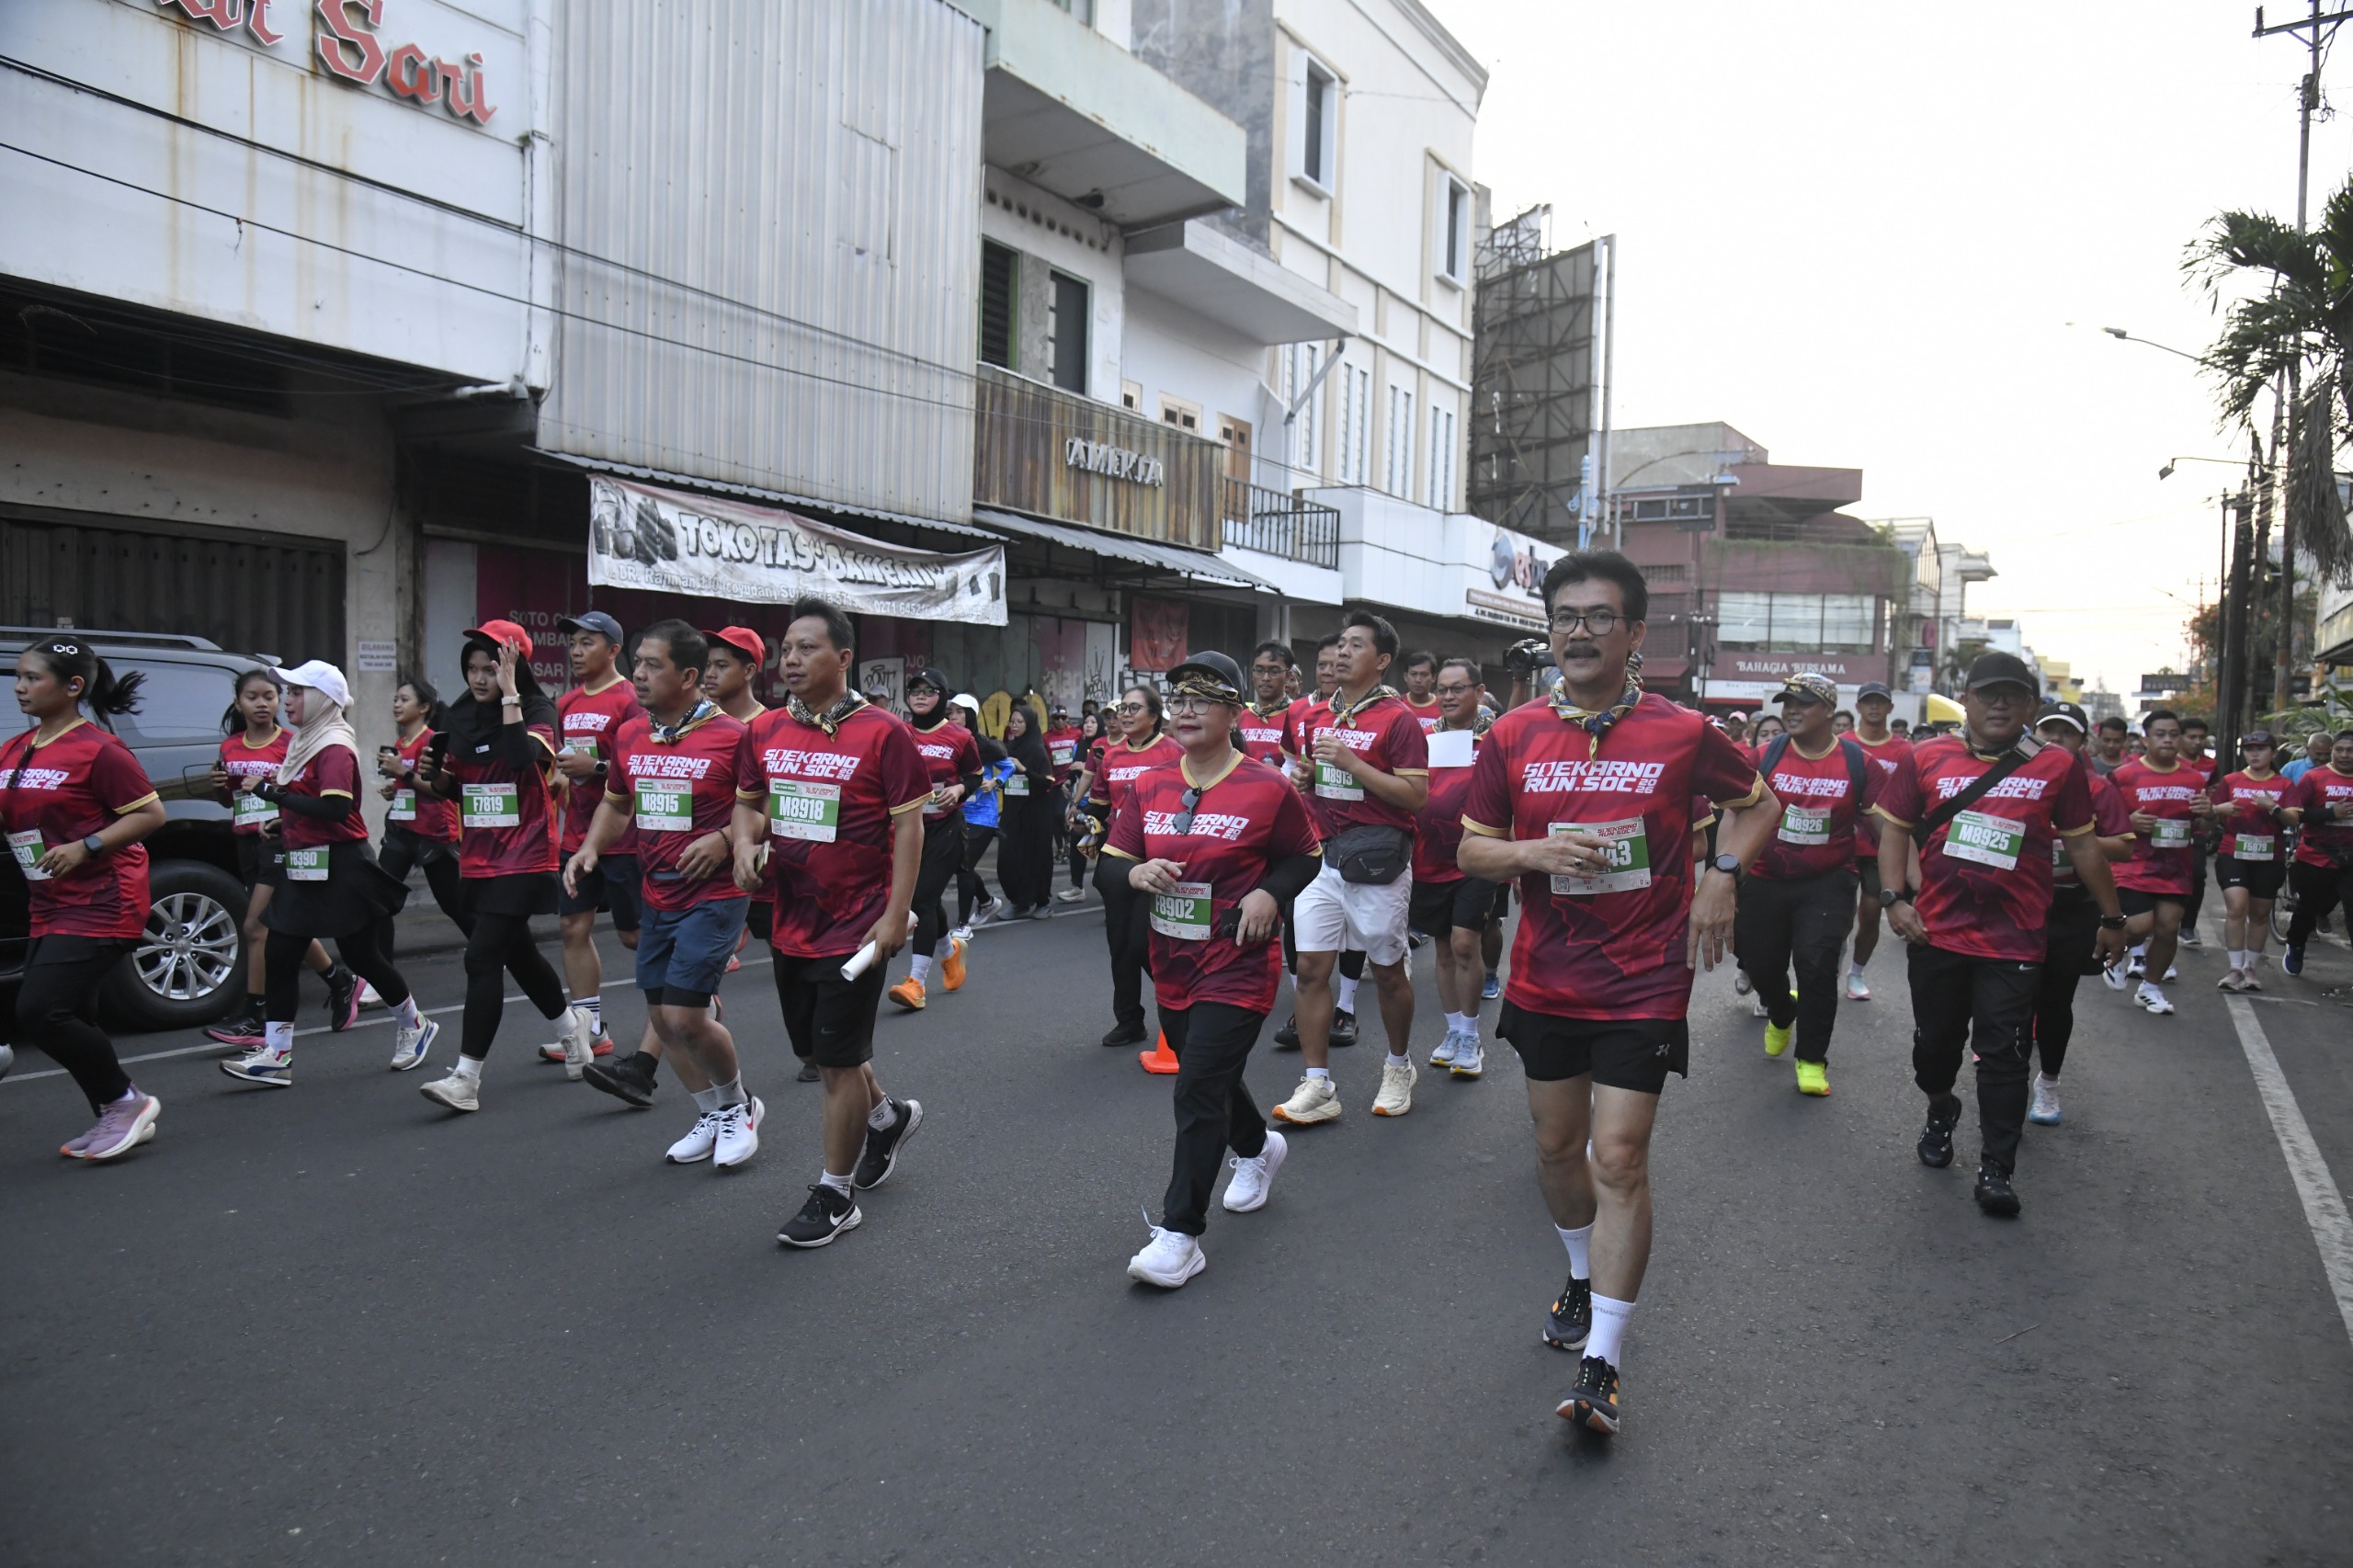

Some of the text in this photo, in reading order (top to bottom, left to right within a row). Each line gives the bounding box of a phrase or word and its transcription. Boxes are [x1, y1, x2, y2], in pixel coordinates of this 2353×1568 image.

[678, 512, 759, 563] TOKO
[759, 526, 816, 573] TAS
[644, 566, 696, 589] Rajiman
[1736, 661, 1789, 675] BAHAGIA
[627, 755, 711, 769] SOEKARNO
[762, 748, 861, 769] SOEKARNO
[629, 765, 692, 778] RUN.SOC
[767, 760, 838, 778] RUN.SOC
[1521, 760, 1665, 778] SOEKARNO
[1523, 777, 1637, 793] RUN.SOC
[1772, 773, 1849, 790] SOEKARNO
[473, 796, 504, 812] F7819
[641, 792, 679, 813] M8915
[779, 795, 824, 821] M8918
[1786, 815, 1823, 832] M8926
[1958, 823, 2011, 851] M8925
[290, 851, 318, 866] F8390
[1155, 892, 1195, 920] F8902
